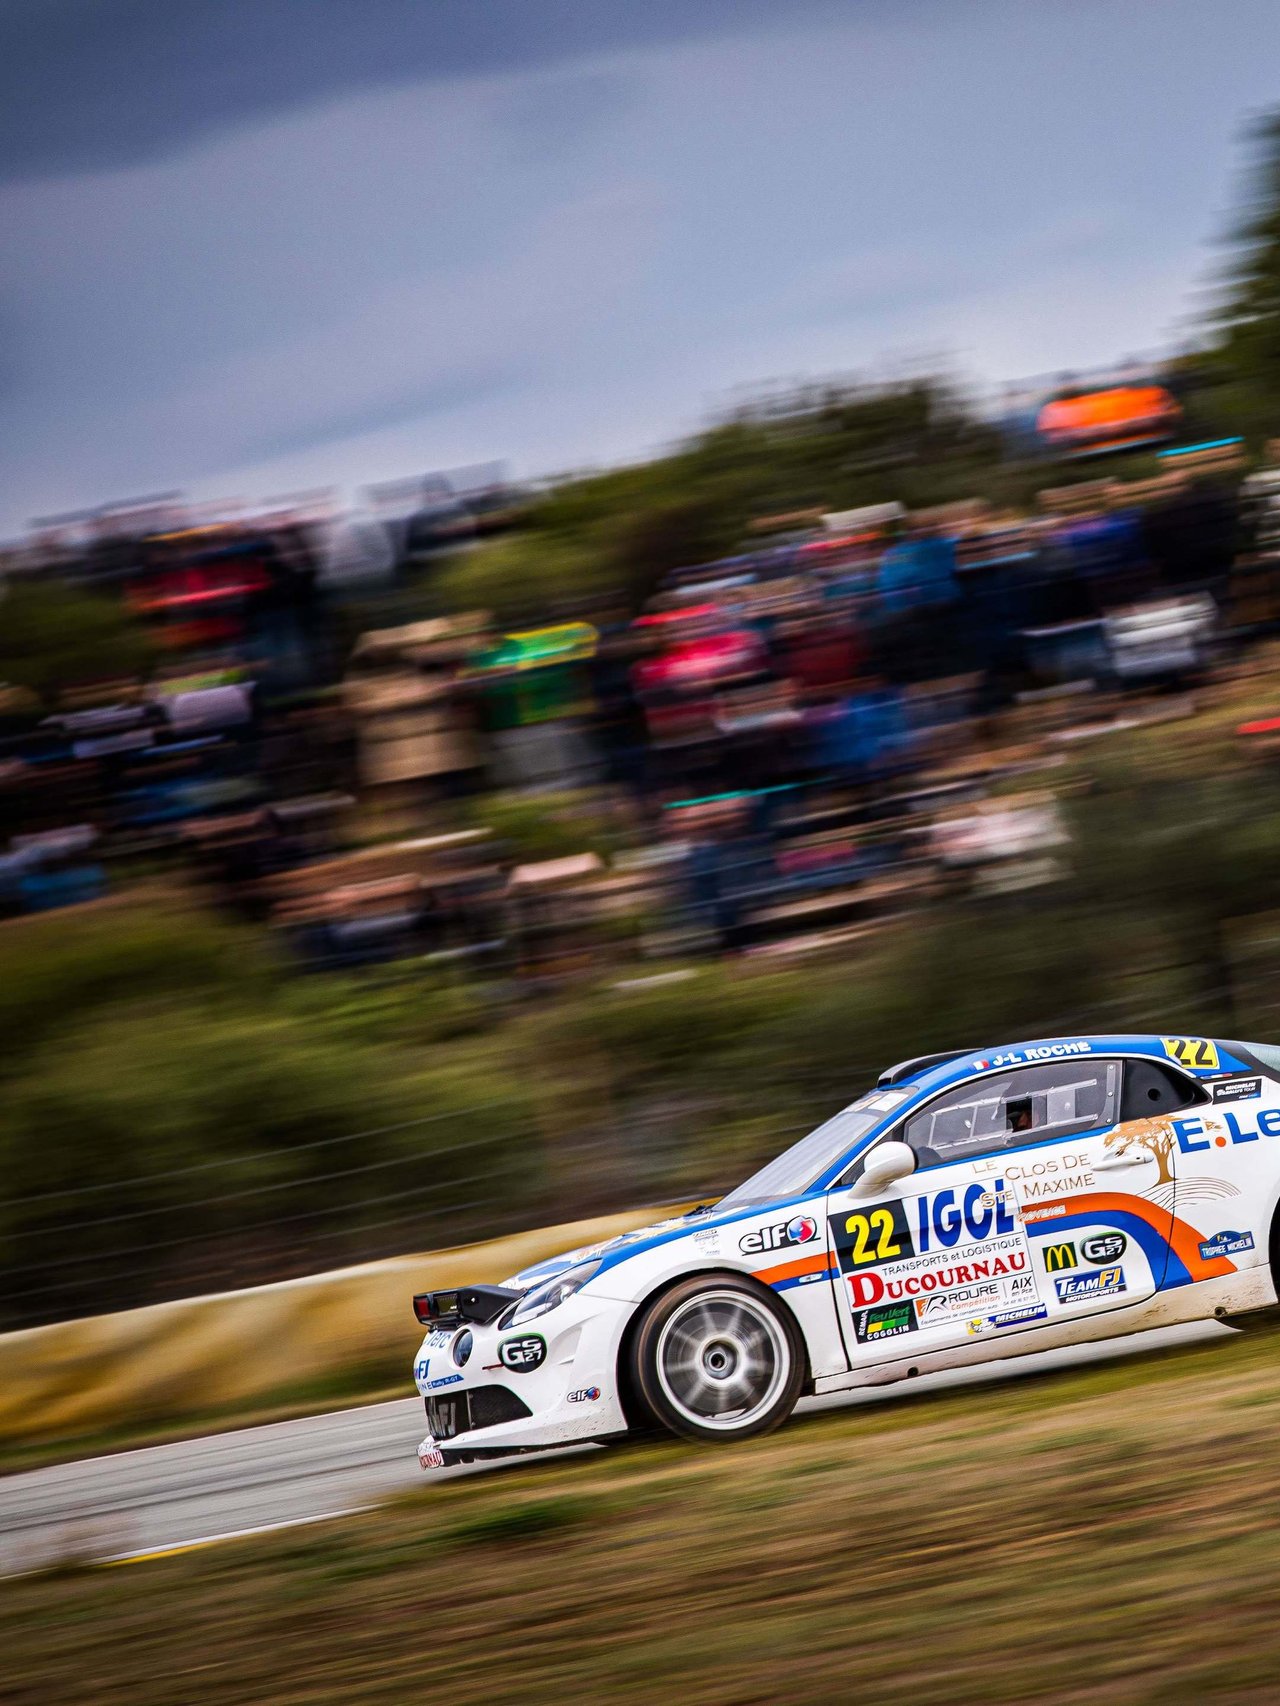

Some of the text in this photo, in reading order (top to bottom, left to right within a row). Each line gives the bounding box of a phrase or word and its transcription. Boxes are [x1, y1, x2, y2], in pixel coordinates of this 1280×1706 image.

[993, 1053, 1022, 1067] J-L
[1167, 1039, 1214, 1066] 22
[972, 1153, 1091, 1181] LE CLOS DE
[980, 1173, 1096, 1208] STE MAXIME
[918, 1178, 1014, 1253] IGOL
[738, 1225, 789, 1253] elf
[845, 1209, 901, 1265] 22
[882, 1238, 1022, 1277] TRANSPORTS et LOGISTIQUE
[848, 1252, 1026, 1308] DUCOURNAU
[949, 1276, 1032, 1304] ROURE AIX
[1065, 1286, 1120, 1303] MOTORSPORTS
[995, 1305, 1046, 1322] MICHELIN
[866, 1324, 910, 1341] COGOLIN
[567, 1389, 588, 1402] elf
